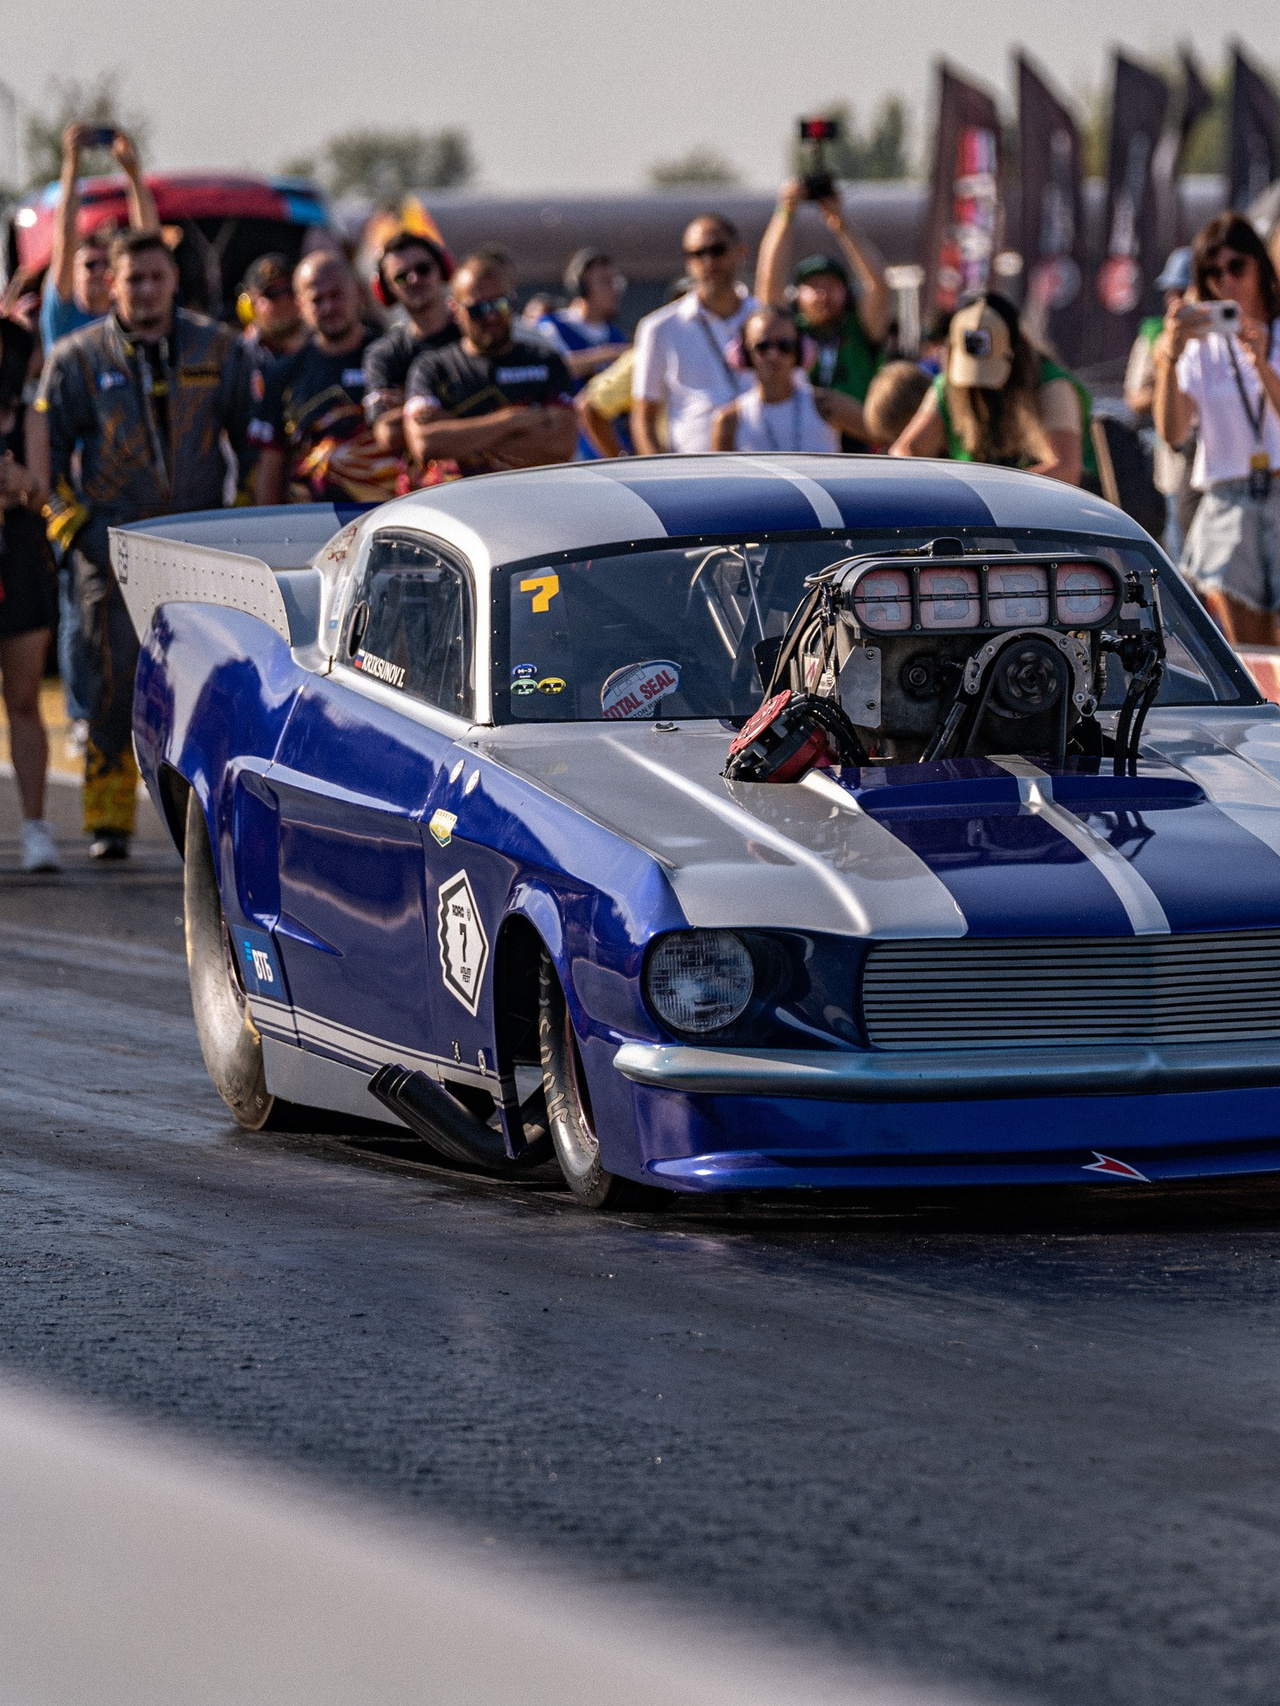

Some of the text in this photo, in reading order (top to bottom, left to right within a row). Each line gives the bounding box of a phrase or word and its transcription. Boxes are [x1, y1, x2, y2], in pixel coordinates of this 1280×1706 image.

[520, 575, 559, 613] 7
[639, 669, 676, 700] SEAL
[459, 922, 467, 963] 7
[252, 949, 274, 982] ВТБ
